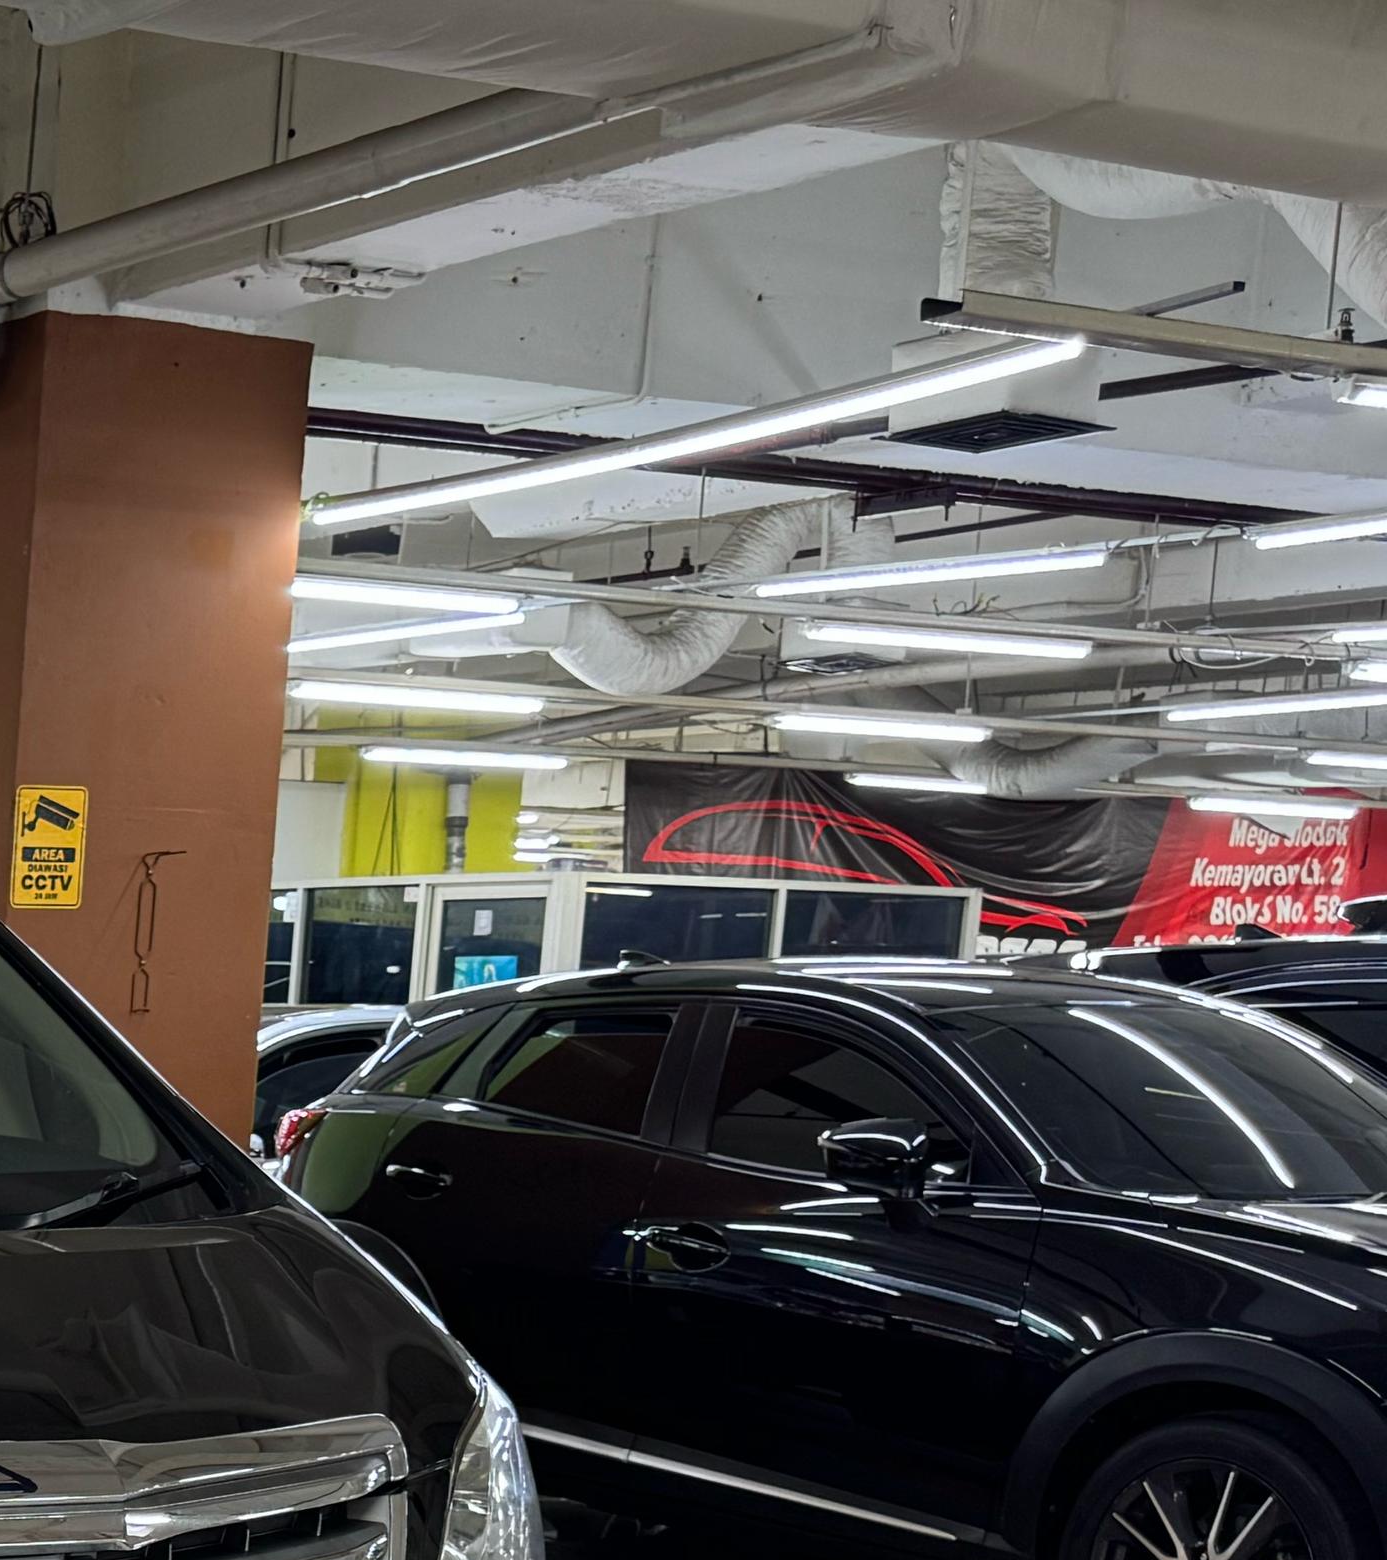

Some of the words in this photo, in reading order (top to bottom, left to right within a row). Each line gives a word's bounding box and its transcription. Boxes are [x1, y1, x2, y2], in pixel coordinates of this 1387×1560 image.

[1228, 817, 1280, 855] Mega
[32, 848, 64, 861] AREA
[28, 864, 68, 872] DIAWASI
[1331, 855, 1346, 886] 2
[21, 874, 73, 891] CCTV
[1275, 895, 1308, 924] No.
